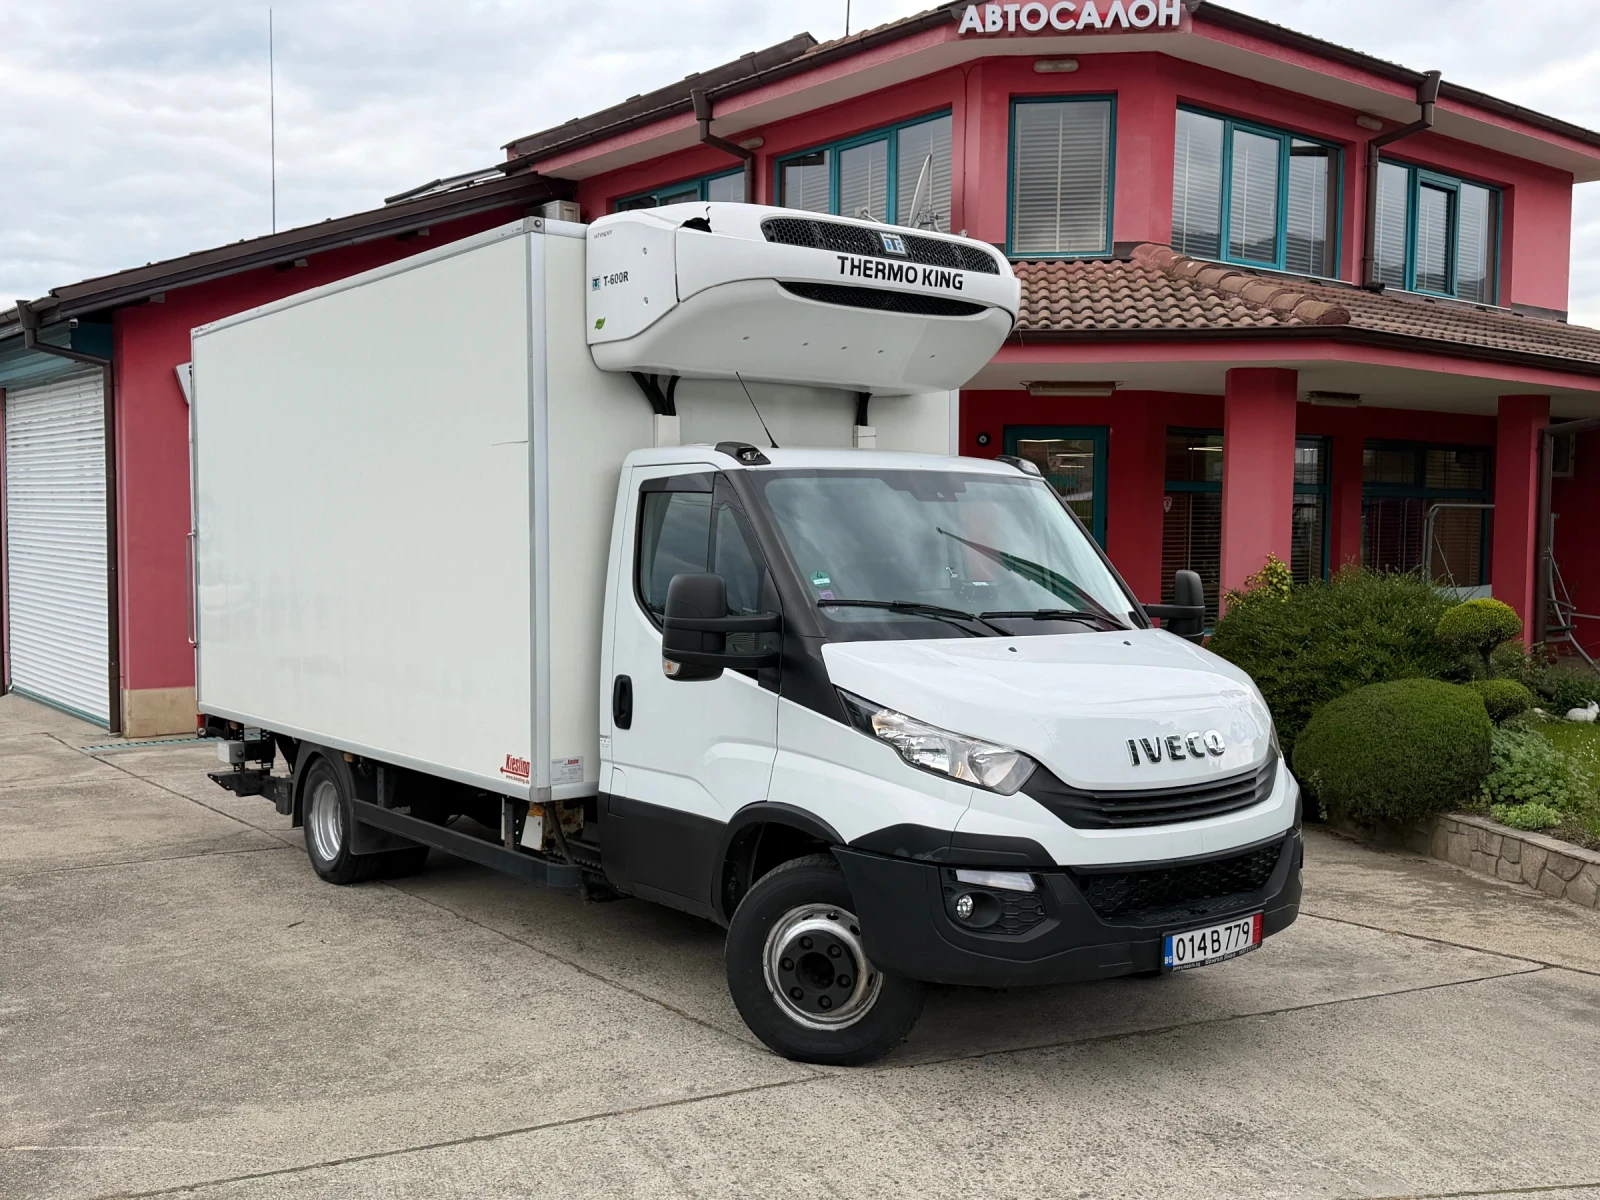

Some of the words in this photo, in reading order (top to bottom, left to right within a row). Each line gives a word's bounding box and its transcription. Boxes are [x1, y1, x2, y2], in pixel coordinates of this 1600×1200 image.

[957, 0, 1181, 35] АВТОСАЛОН
[603, 271, 629, 286] T-600R
[836, 255, 918, 284] THERMO
[921, 267, 964, 291] KING
[1124, 729, 1226, 767] IVECO
[1164, 955, 1173, 965] BG
